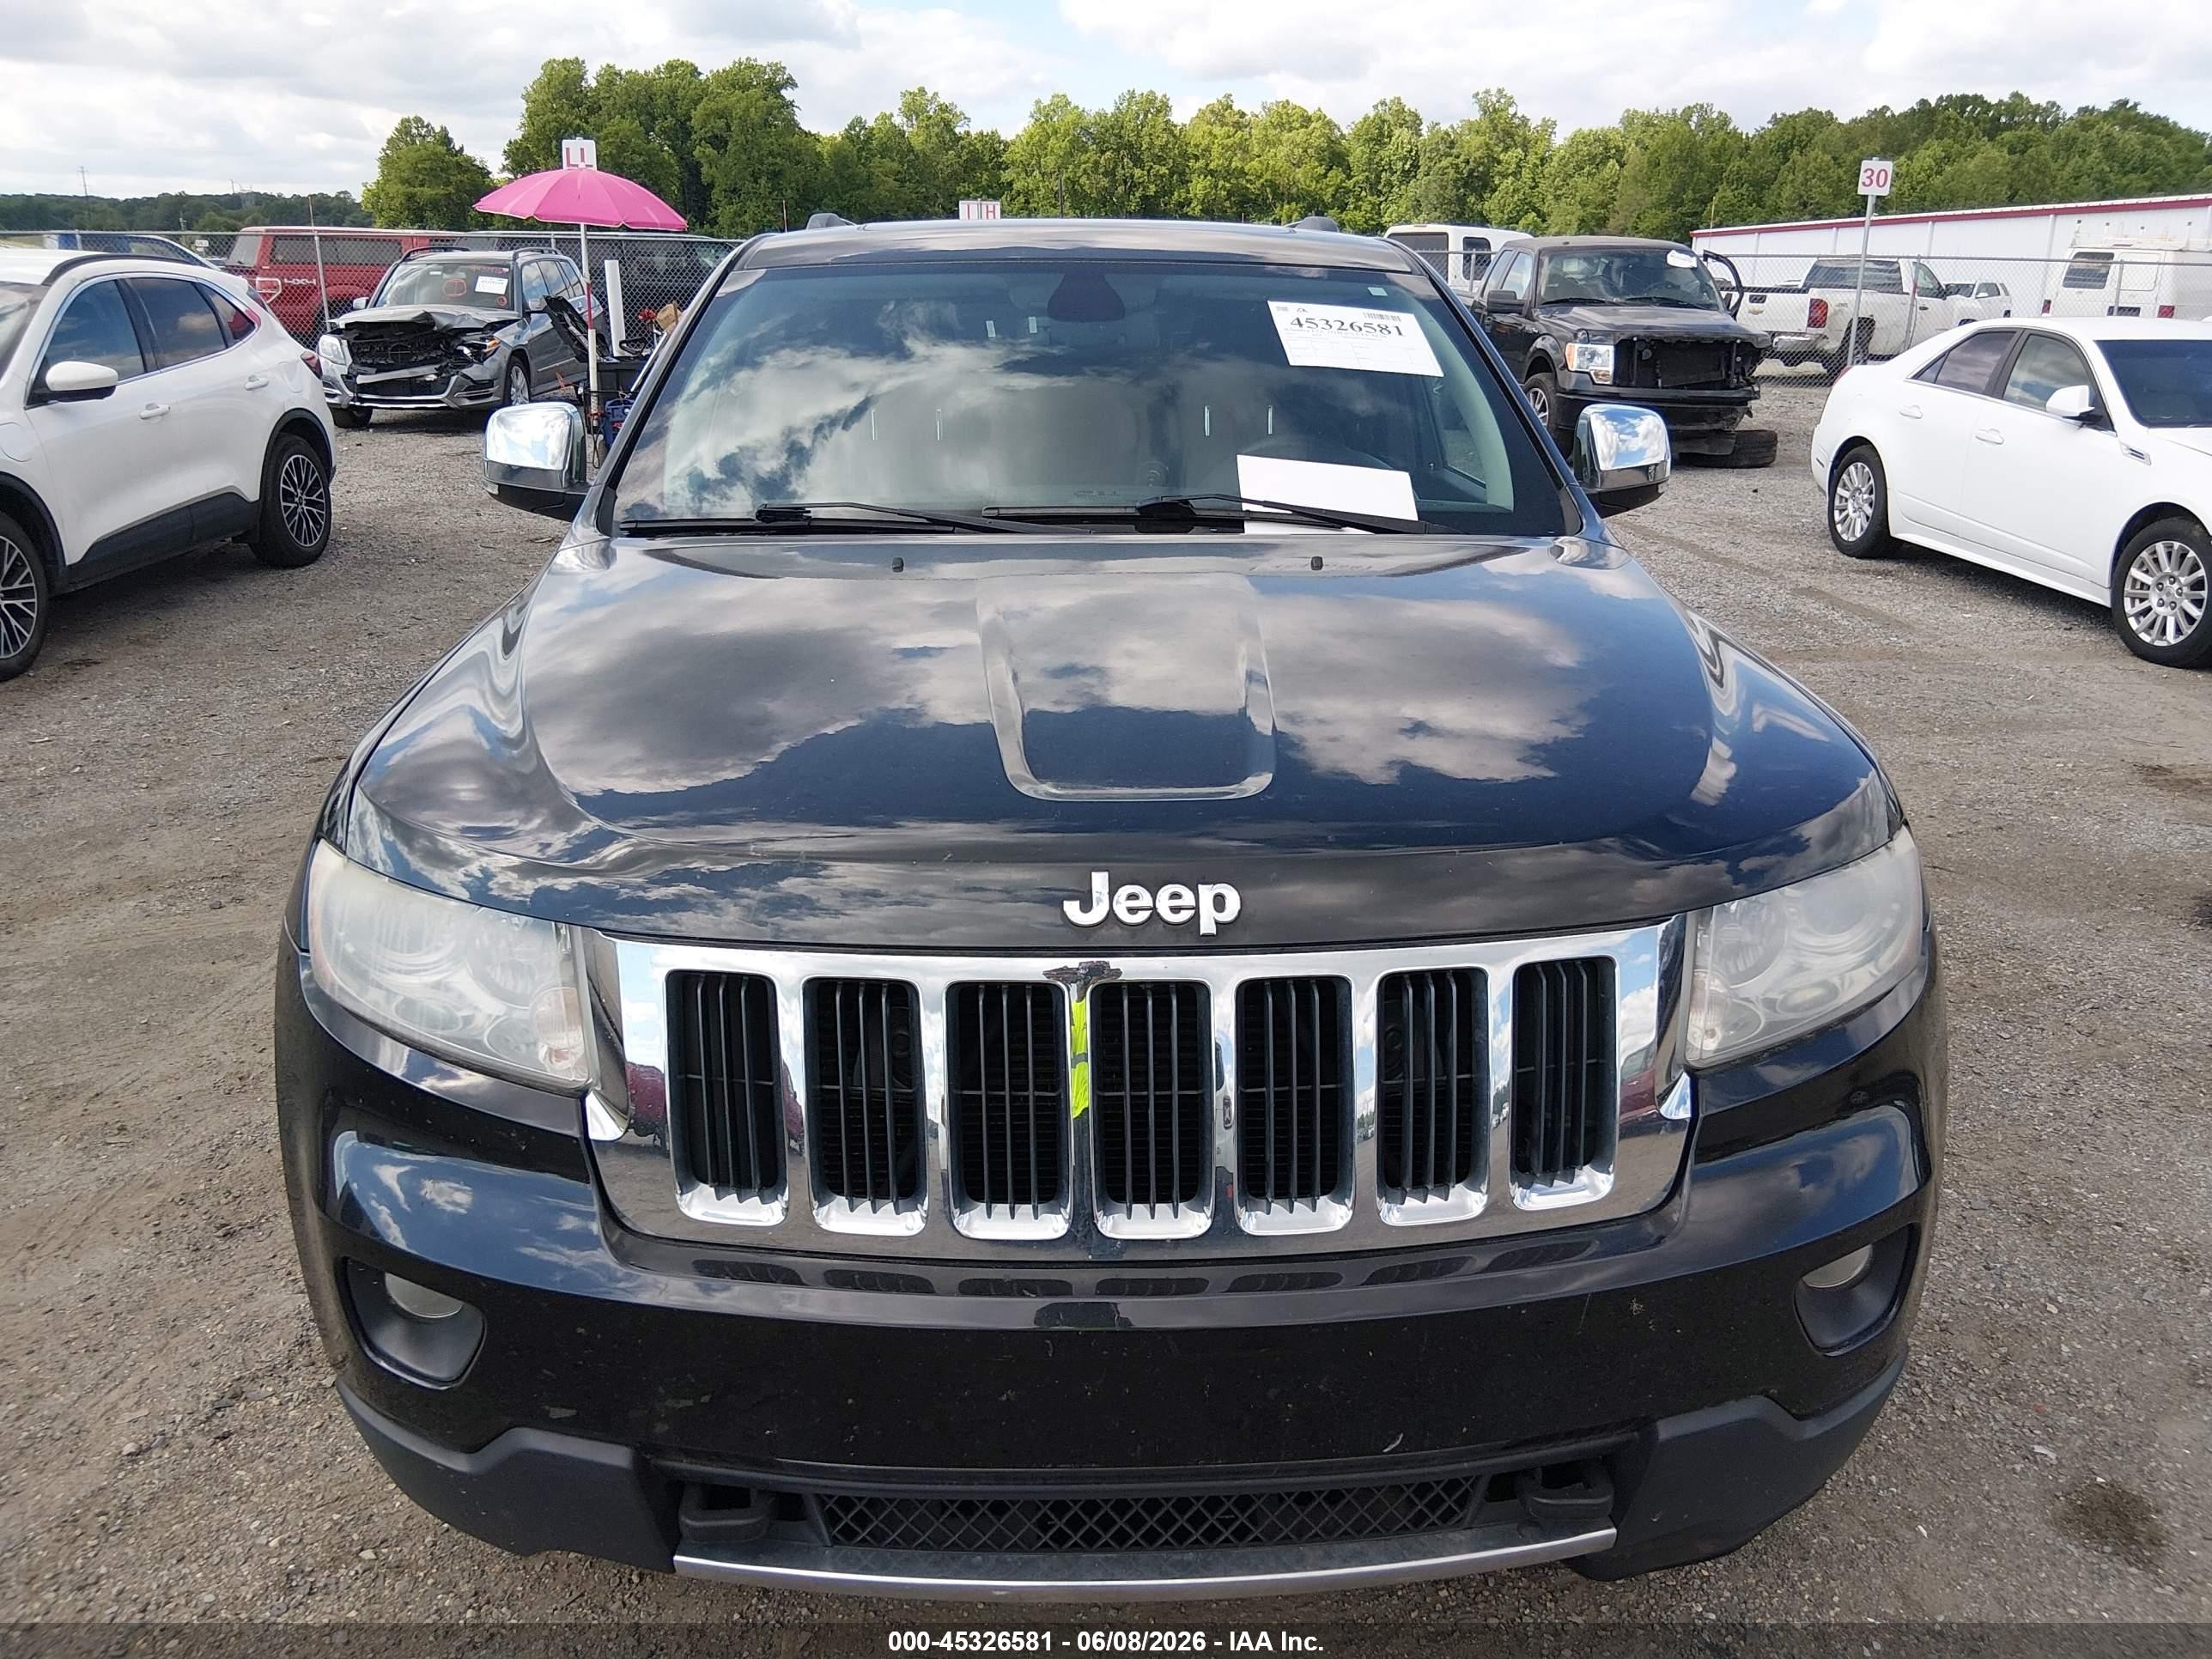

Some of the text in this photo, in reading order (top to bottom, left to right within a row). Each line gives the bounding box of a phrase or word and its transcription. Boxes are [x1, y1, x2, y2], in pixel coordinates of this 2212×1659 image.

[565, 147, 593, 168] LL
[1862, 167, 1888, 188] 30
[1290, 315, 1407, 337] 45326581
[1062, 870, 1242, 937] Jeep
